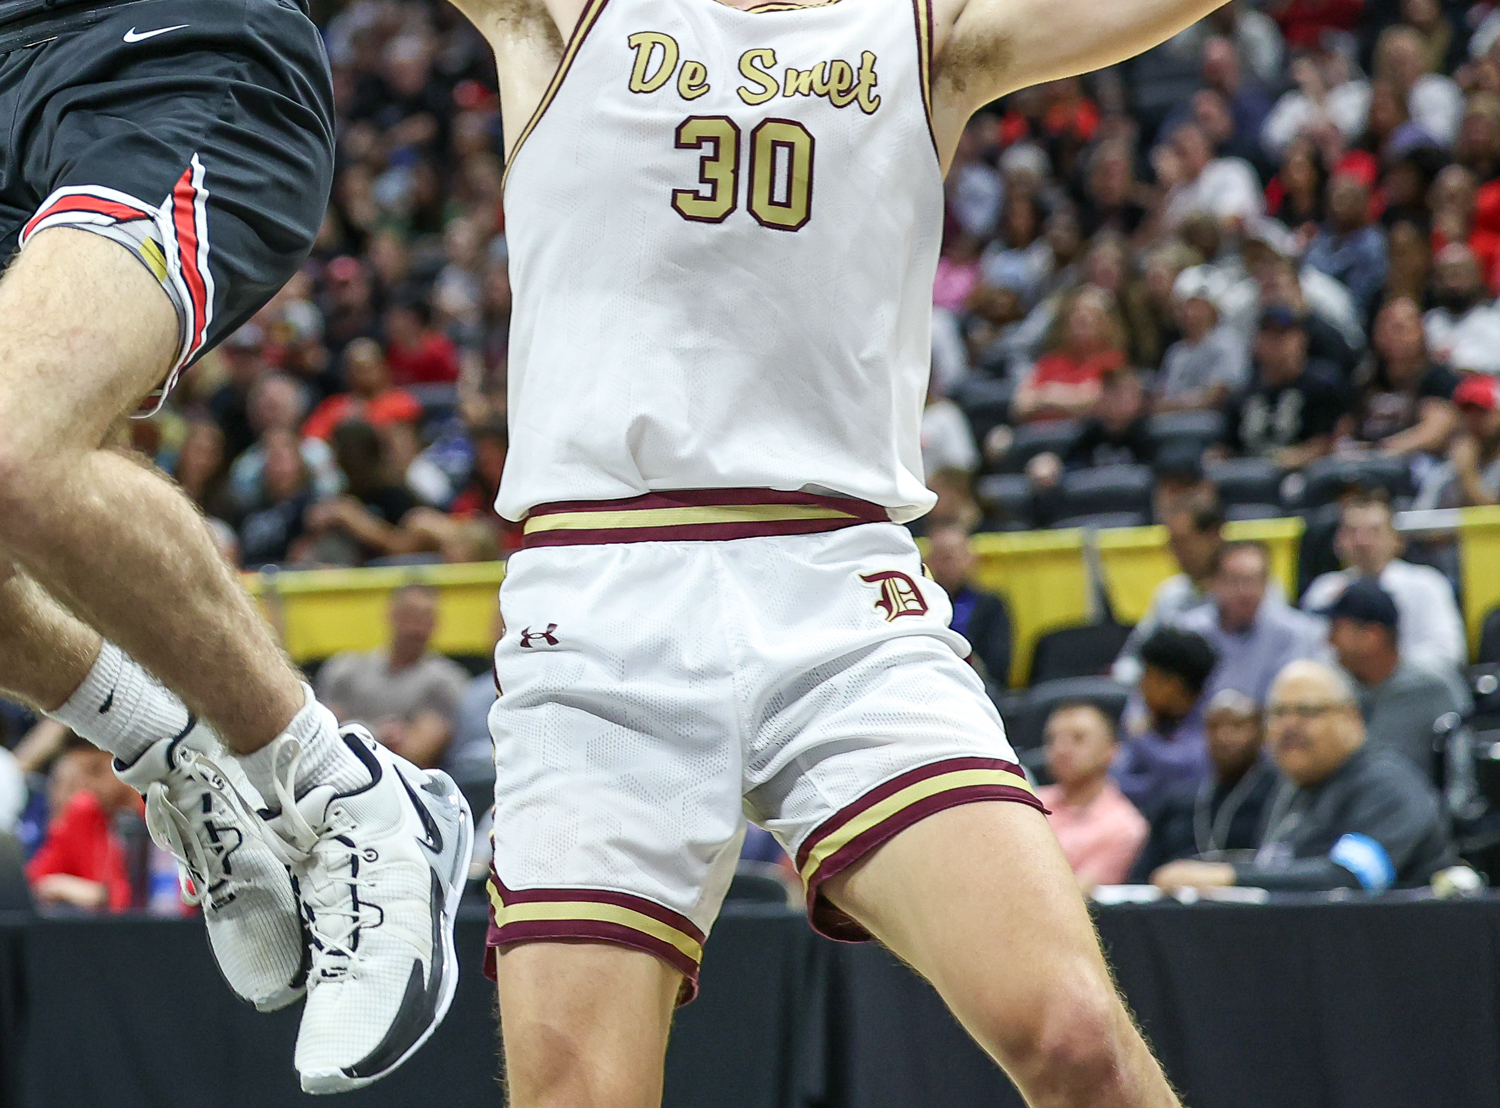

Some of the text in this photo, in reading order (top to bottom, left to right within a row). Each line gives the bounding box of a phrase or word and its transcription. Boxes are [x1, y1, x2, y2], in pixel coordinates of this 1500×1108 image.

[628, 30, 881, 115] De Smet
[671, 115, 816, 232] 30
[859, 570, 929, 623] D
